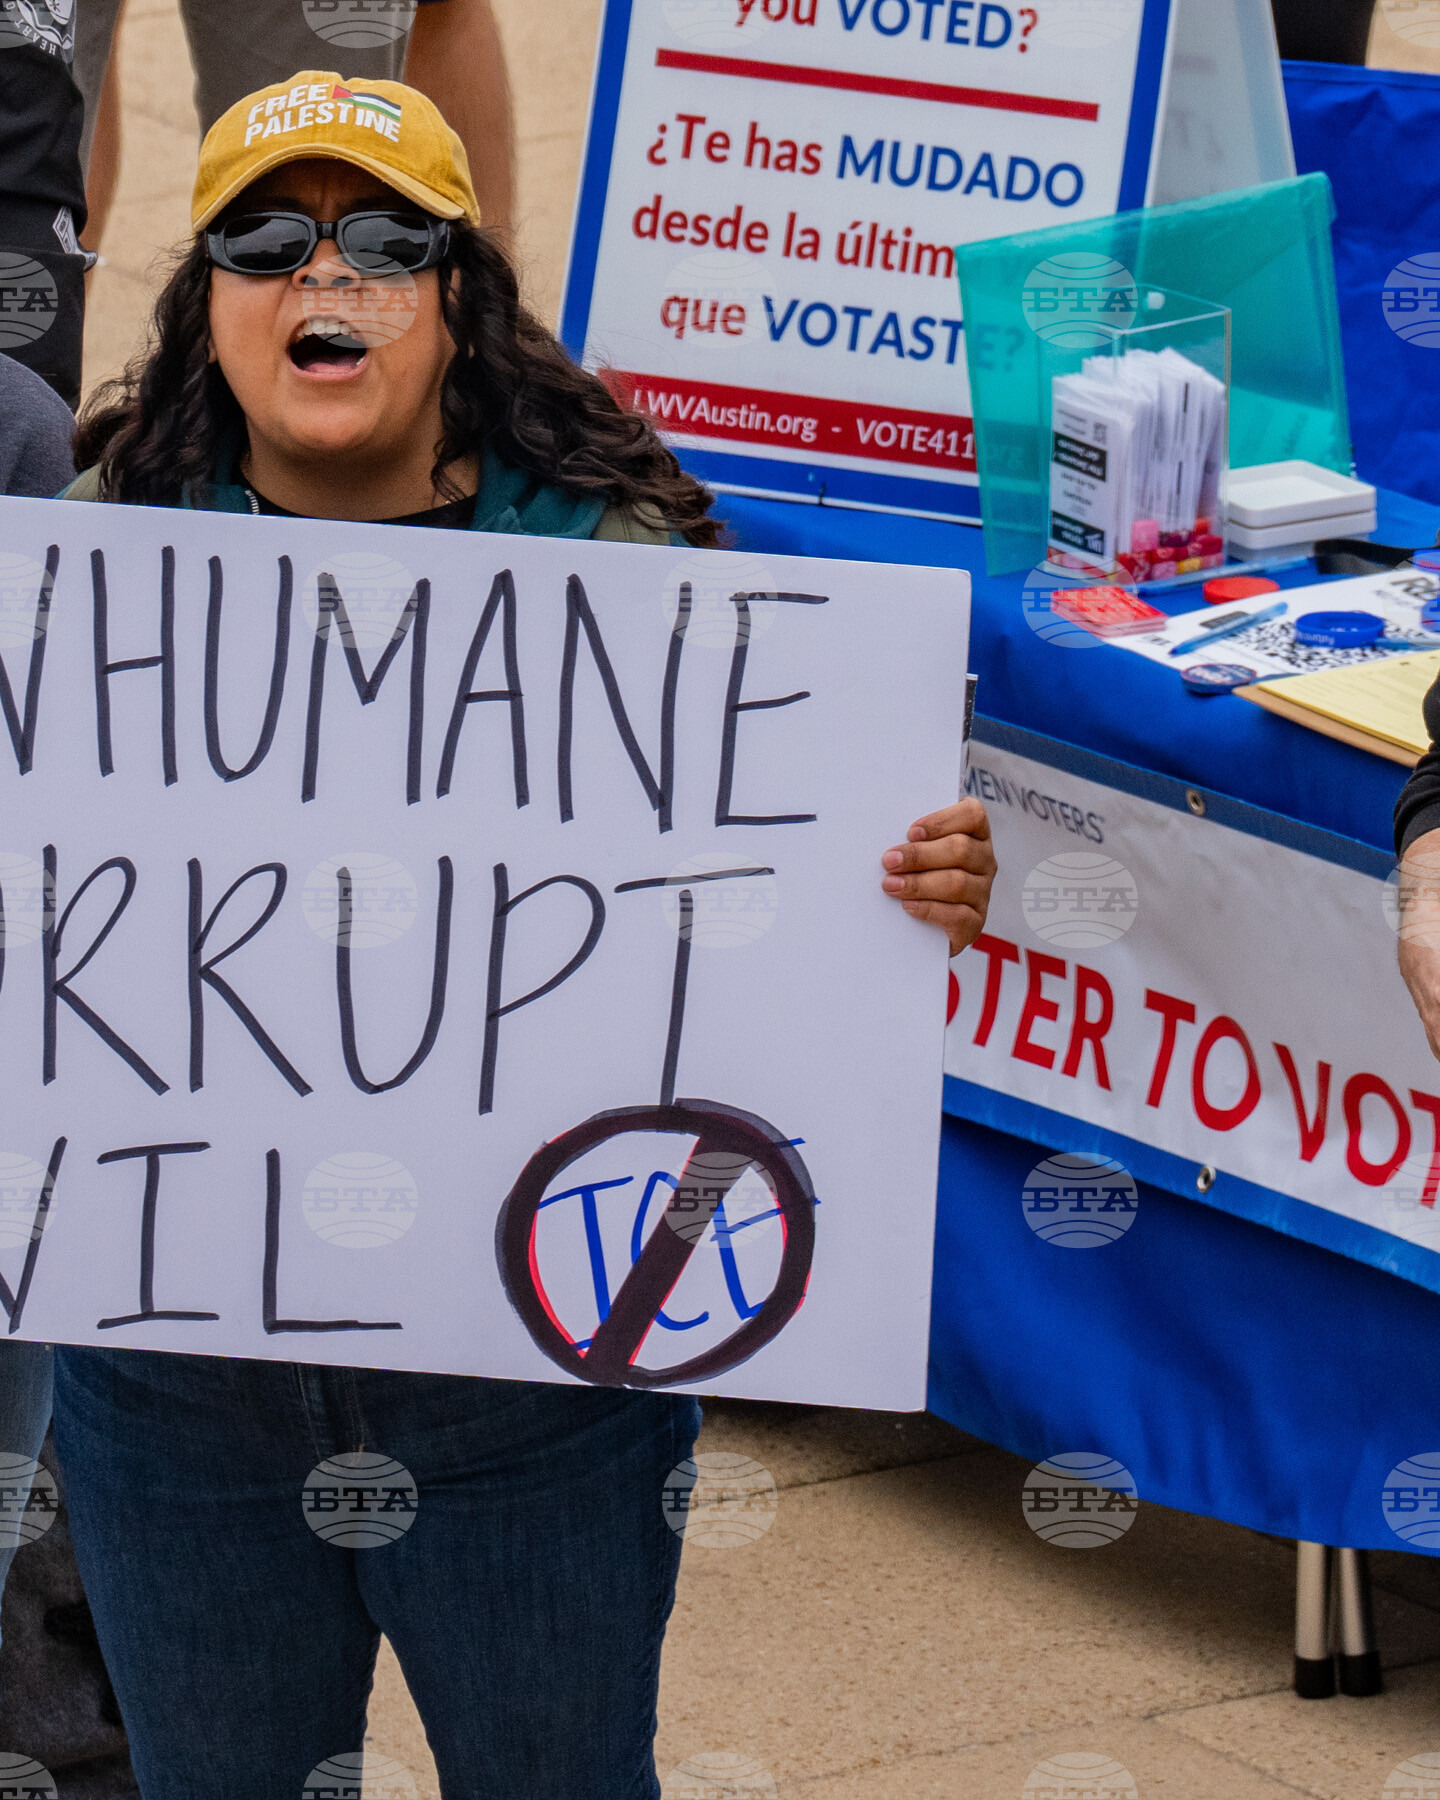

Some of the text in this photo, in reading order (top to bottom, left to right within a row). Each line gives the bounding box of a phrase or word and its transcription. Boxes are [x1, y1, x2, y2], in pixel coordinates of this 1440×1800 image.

[14, 19, 57, 56] HEART
[244, 102, 402, 148] PALESTINE
[247, 83, 330, 125] FREE
[646, 113, 1086, 208] ¿Te has MUDADO
[631, 194, 972, 280] desde la últim
[660, 294, 747, 339] que
[1009, 781, 1104, 845] VOTERS
[1145, 988, 1262, 1132] TO
